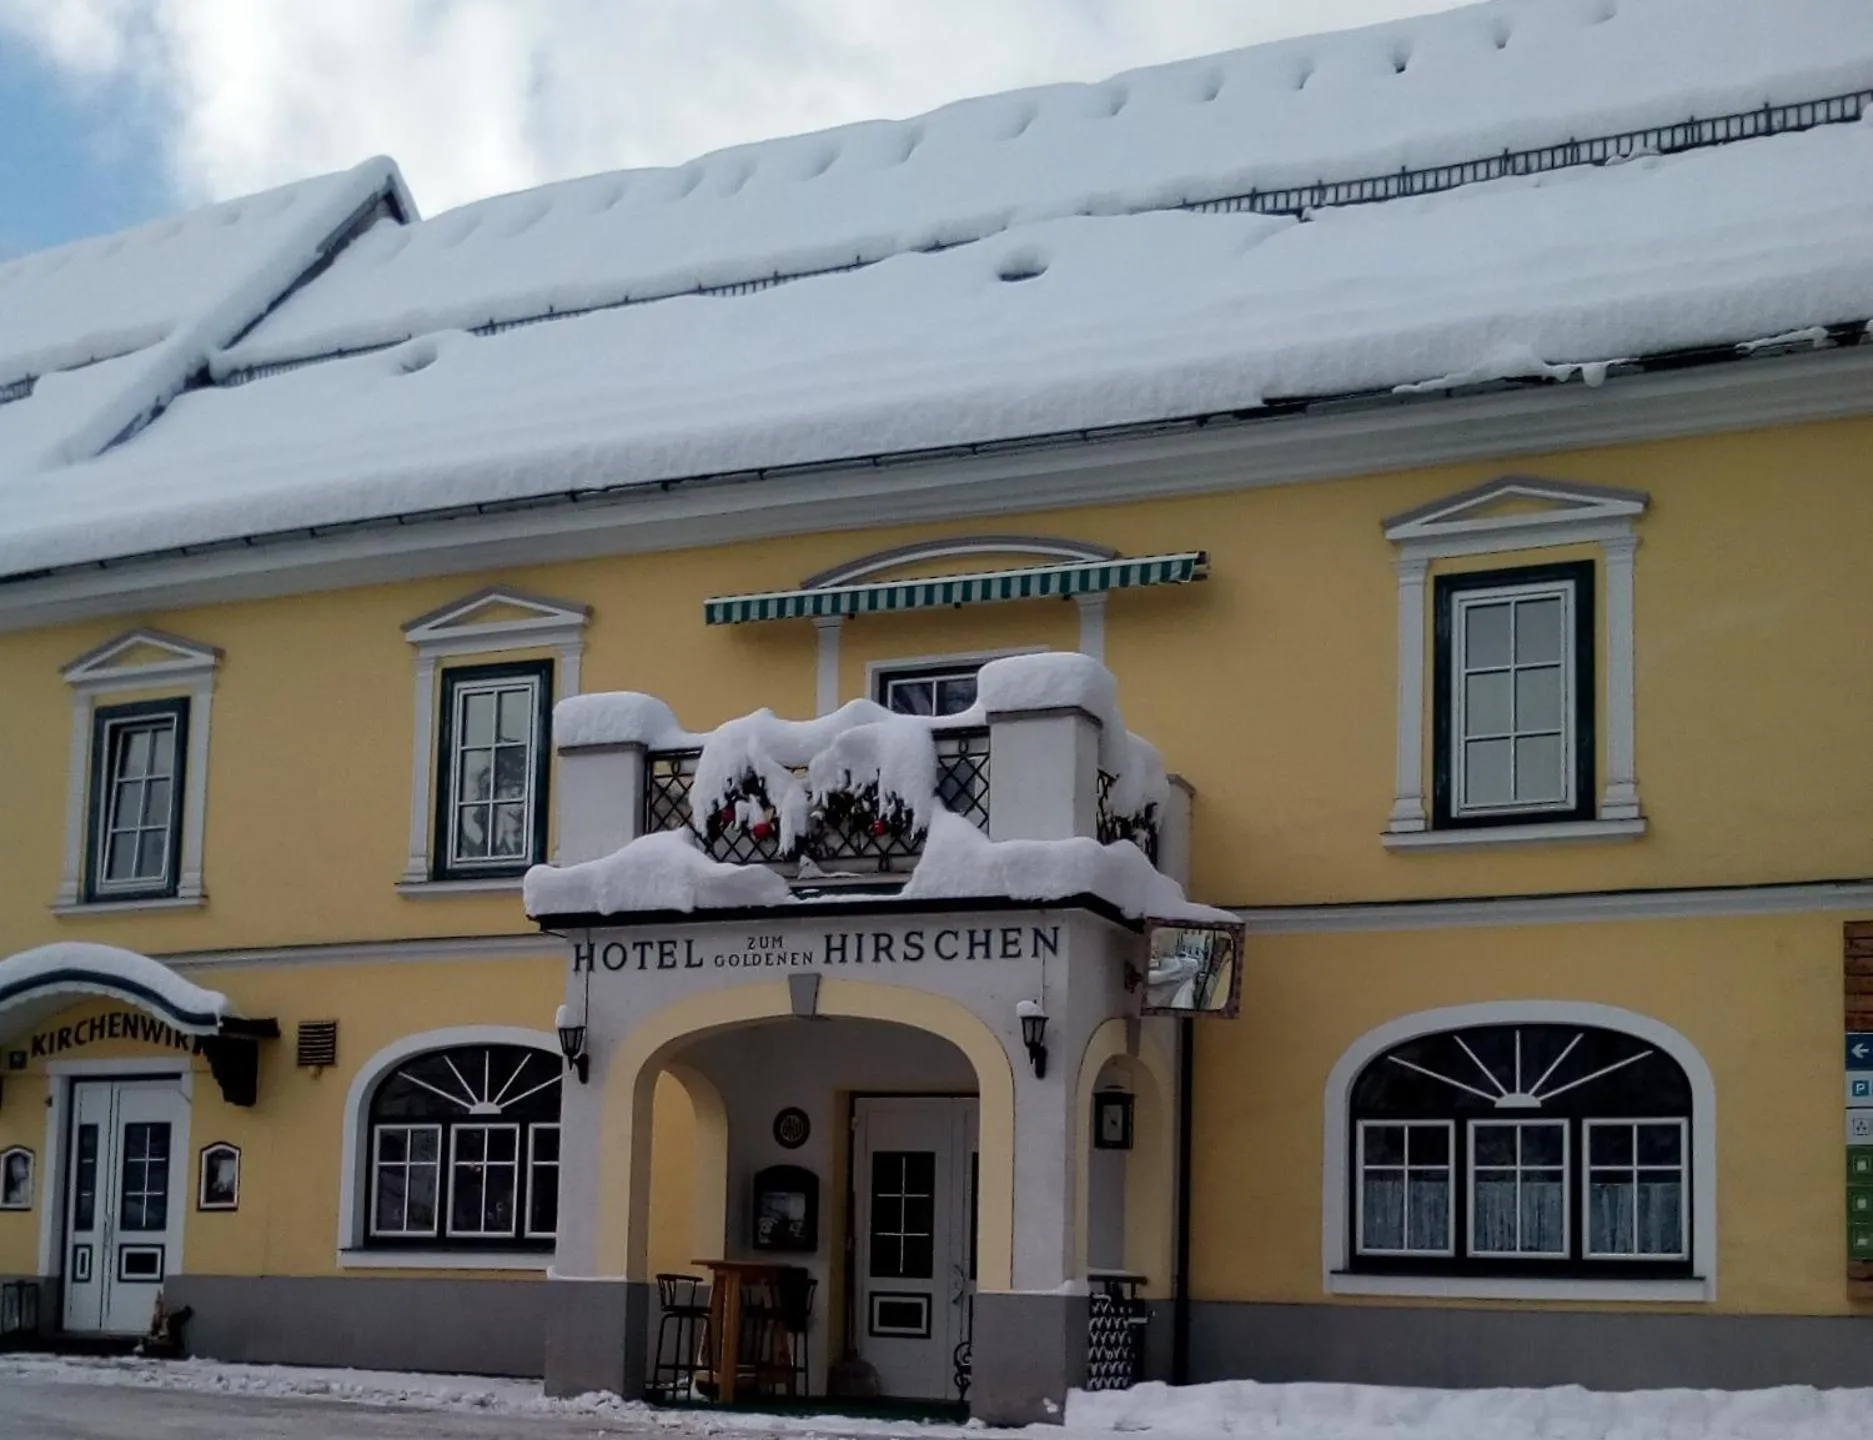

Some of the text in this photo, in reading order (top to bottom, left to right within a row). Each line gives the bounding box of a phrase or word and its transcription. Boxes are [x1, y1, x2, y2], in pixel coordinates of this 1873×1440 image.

[573, 926, 1061, 972] HOTEL HIRSCHEN
[747, 936, 783, 950] ZUM
[714, 952, 813, 968] GOLDENEN
